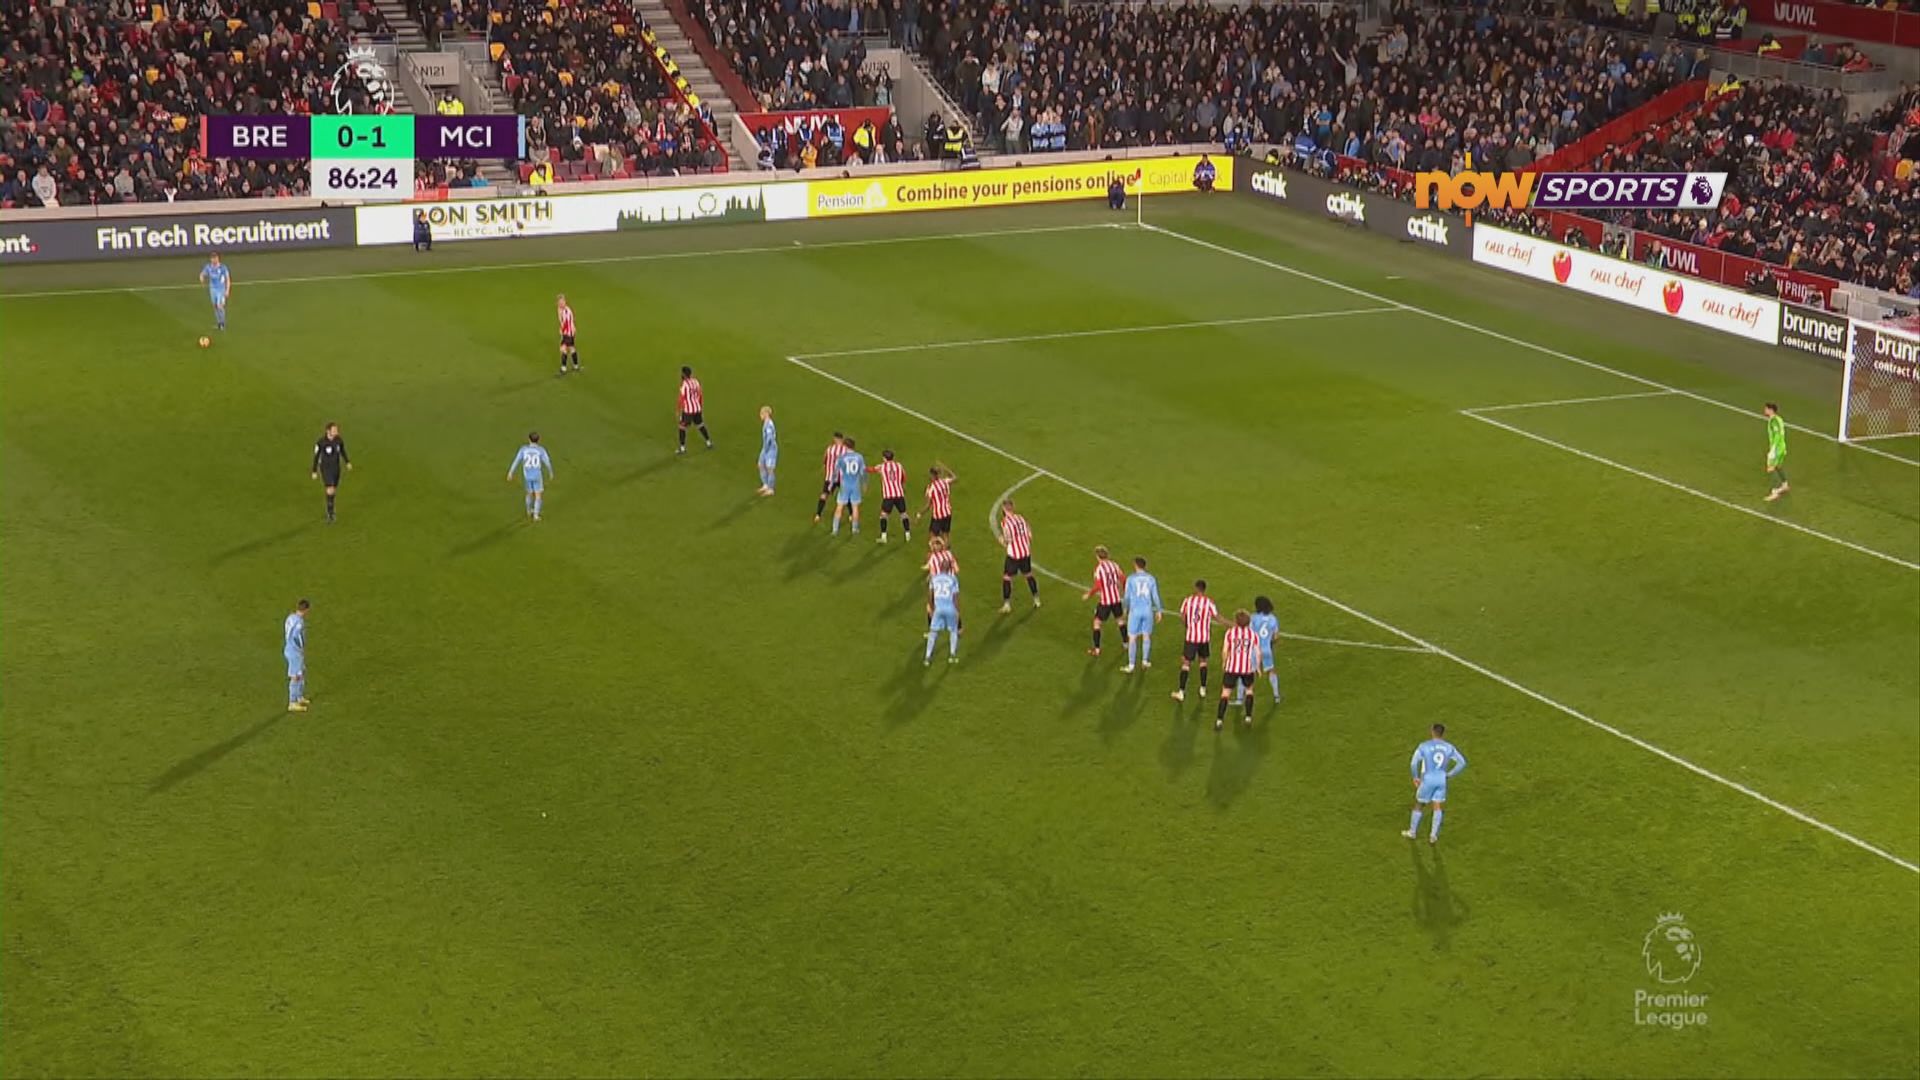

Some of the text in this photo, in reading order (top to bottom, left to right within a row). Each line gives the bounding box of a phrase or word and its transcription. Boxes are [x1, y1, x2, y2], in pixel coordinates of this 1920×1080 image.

[1786, 3, 1817, 25] UWL
[896, 182, 968, 203] Combine
[972, 182, 1008, 202] your
[1012, 174, 1082, 199] pensions
[1148, 169, 1187, 187] Capital
[1251, 170, 1287, 198] octink
[818, 192, 864, 208] Pension
[1326, 191, 1365, 221] octink
[476, 201, 552, 224] SMITH
[97, 218, 330, 249] FinTech Recruitment
[1407, 215, 1449, 245] octink
[1507, 242, 1535, 265] chef
[1667, 246, 1699, 274] UWL
[1615, 271, 1646, 296] chef
[1729, 302, 1764, 328] chef
[1783, 306, 1844, 343] brunner
[1782, 335, 1816, 352] contract
[1873, 361, 1910, 378] contract
[525, 454, 540, 468] 20
[845, 461, 859, 475] 10
[1136, 581, 1150, 597] 14
[1260, 622, 1269, 638] 6
[1433, 752, 1444, 769] 9
